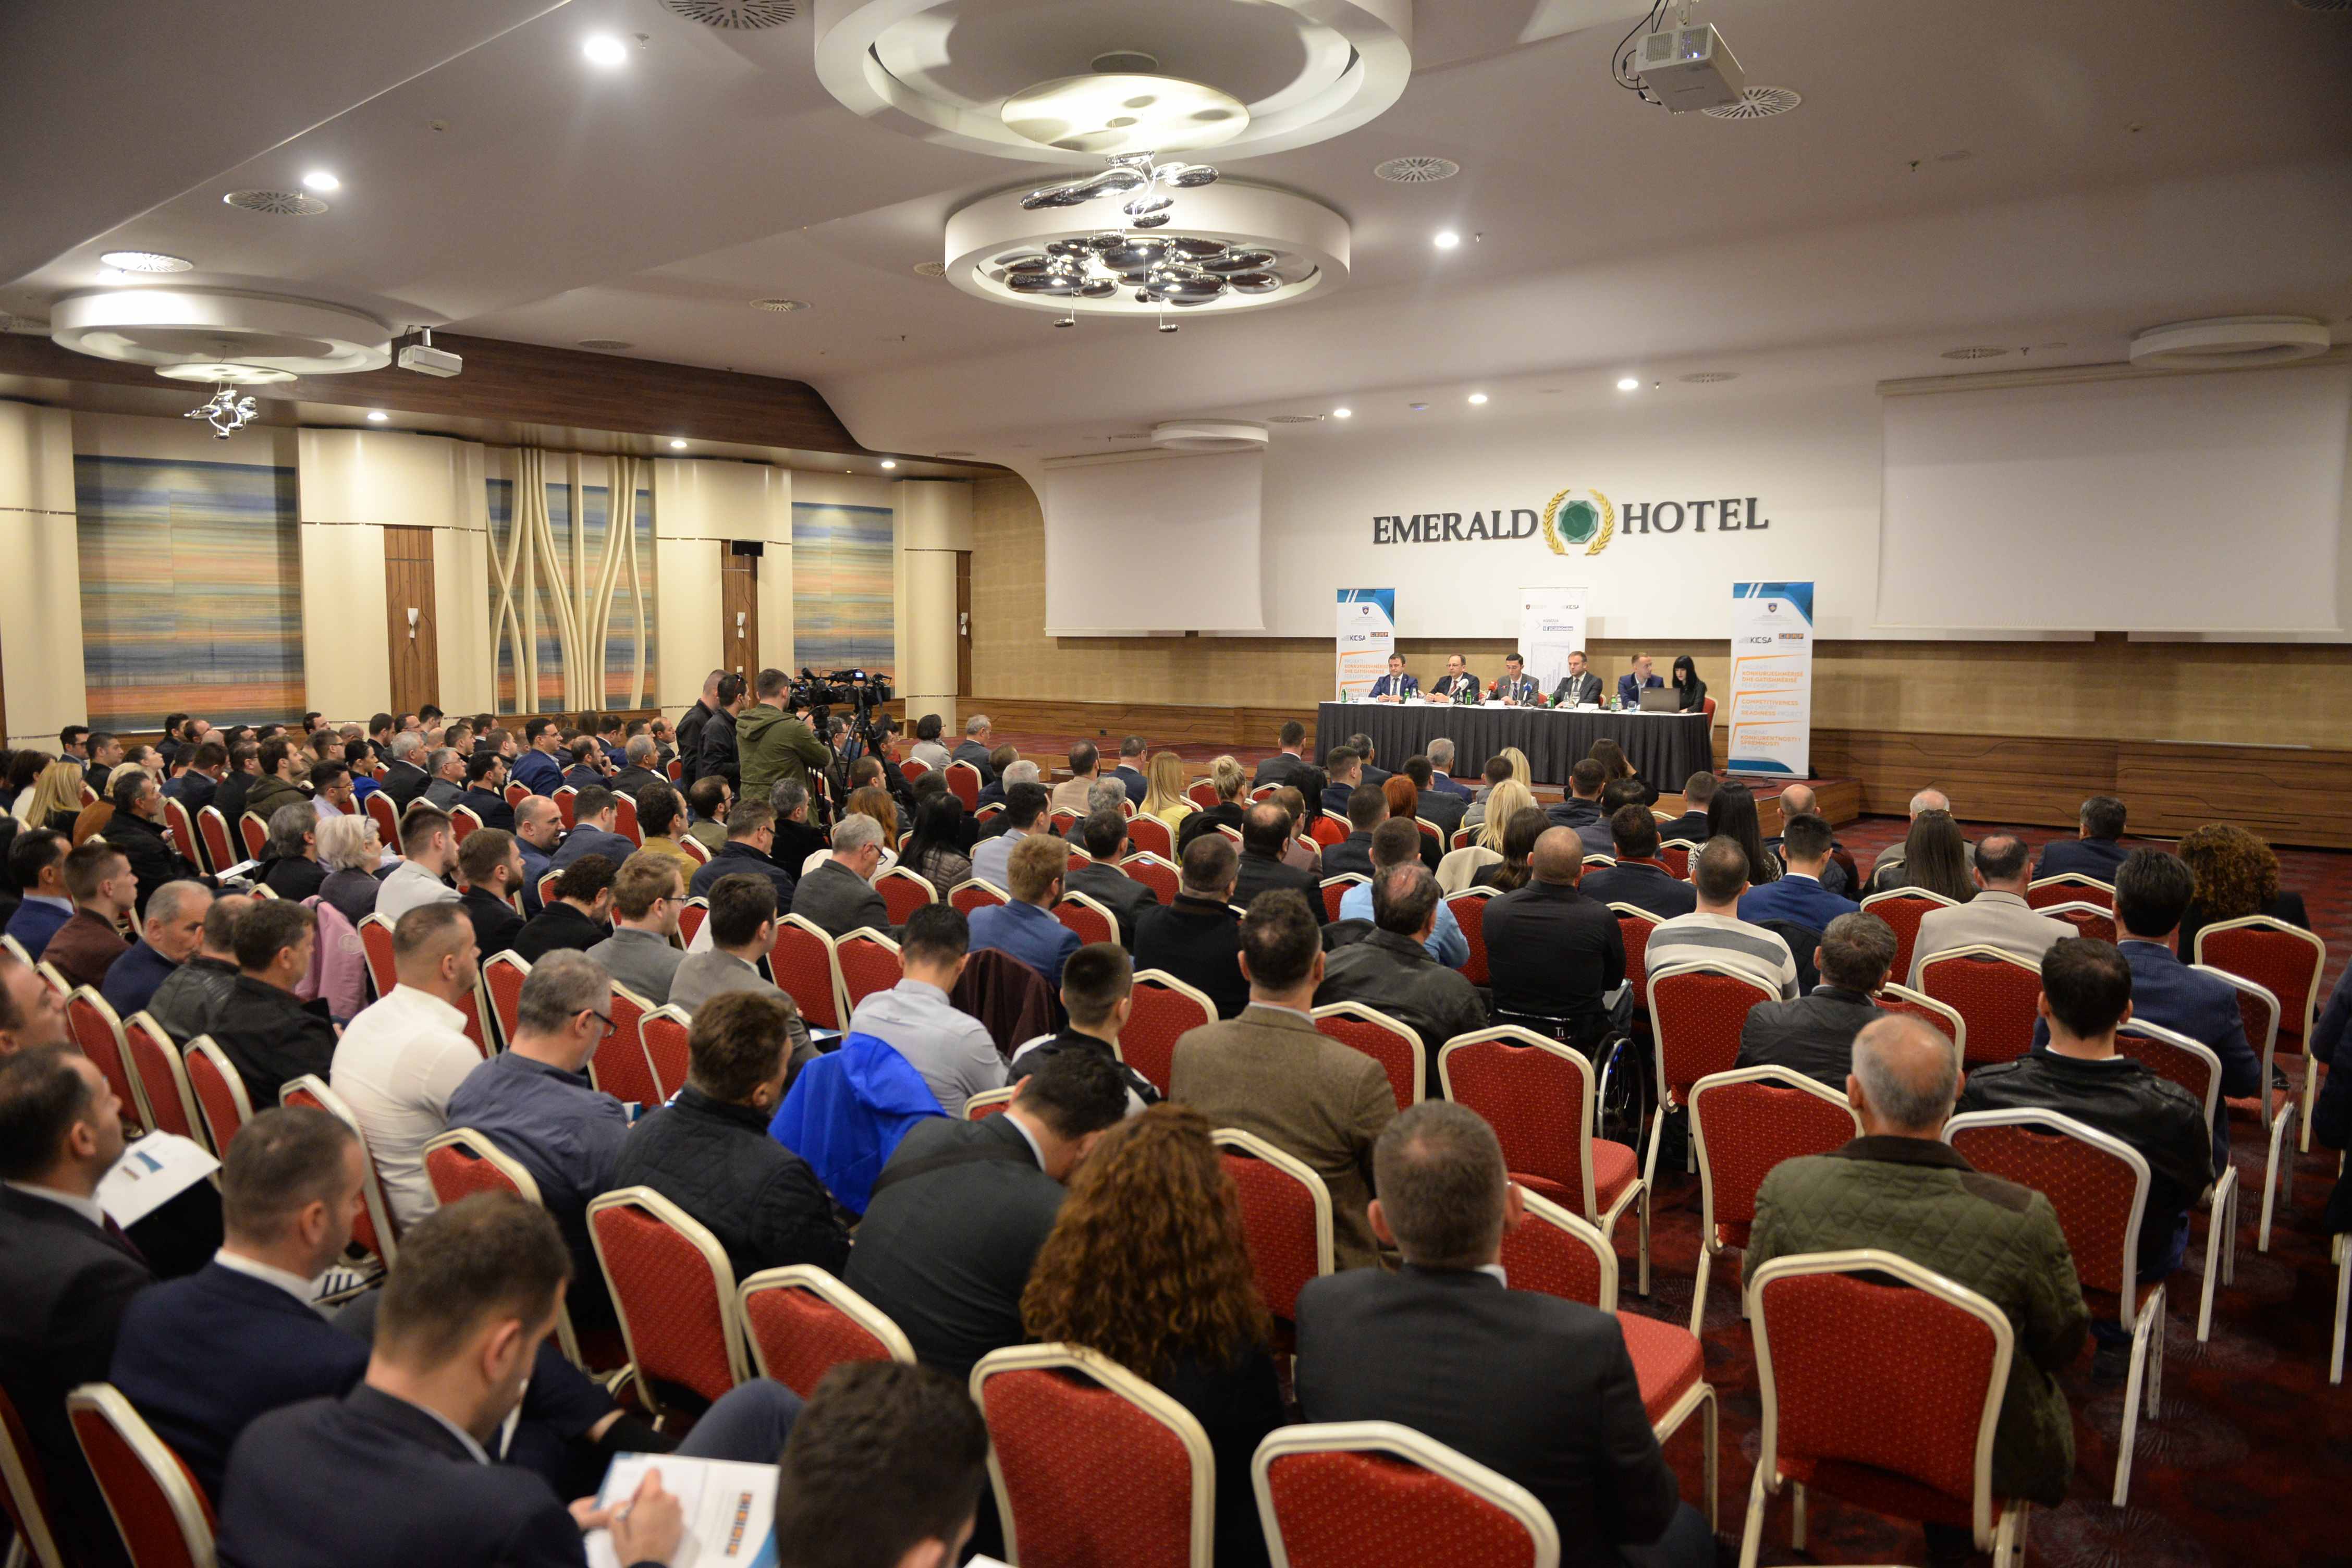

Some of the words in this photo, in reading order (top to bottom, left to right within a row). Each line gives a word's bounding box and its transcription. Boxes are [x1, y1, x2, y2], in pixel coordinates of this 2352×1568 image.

[1373, 509, 1538, 544] EMERALD
[1621, 497, 1769, 534] HOTEL
[1555, 1027, 1564, 1037] Ti
